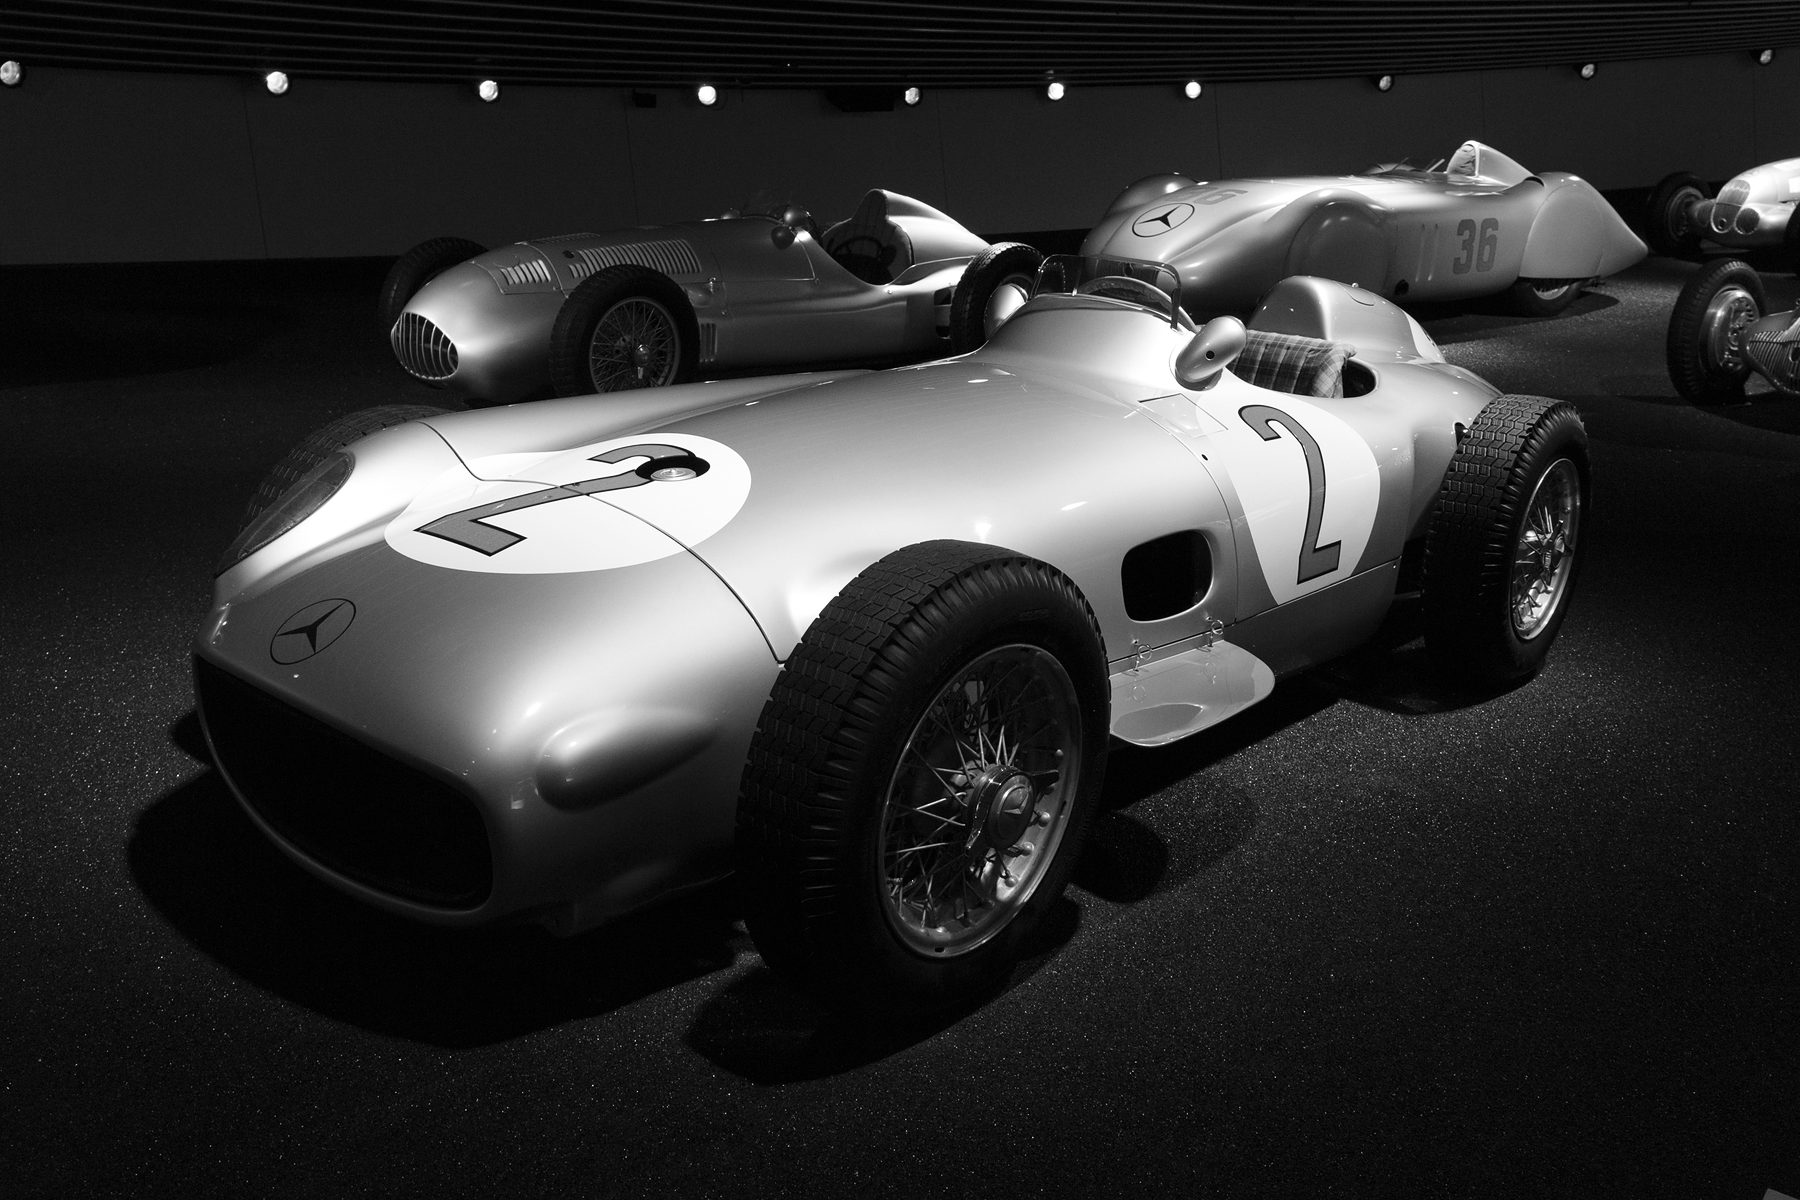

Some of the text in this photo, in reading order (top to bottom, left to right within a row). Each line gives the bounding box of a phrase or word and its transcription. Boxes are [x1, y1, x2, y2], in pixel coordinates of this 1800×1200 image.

[1453, 217, 1499, 275] 36
[413, 443, 698, 557] 2
[1238, 404, 1341, 585] 2
